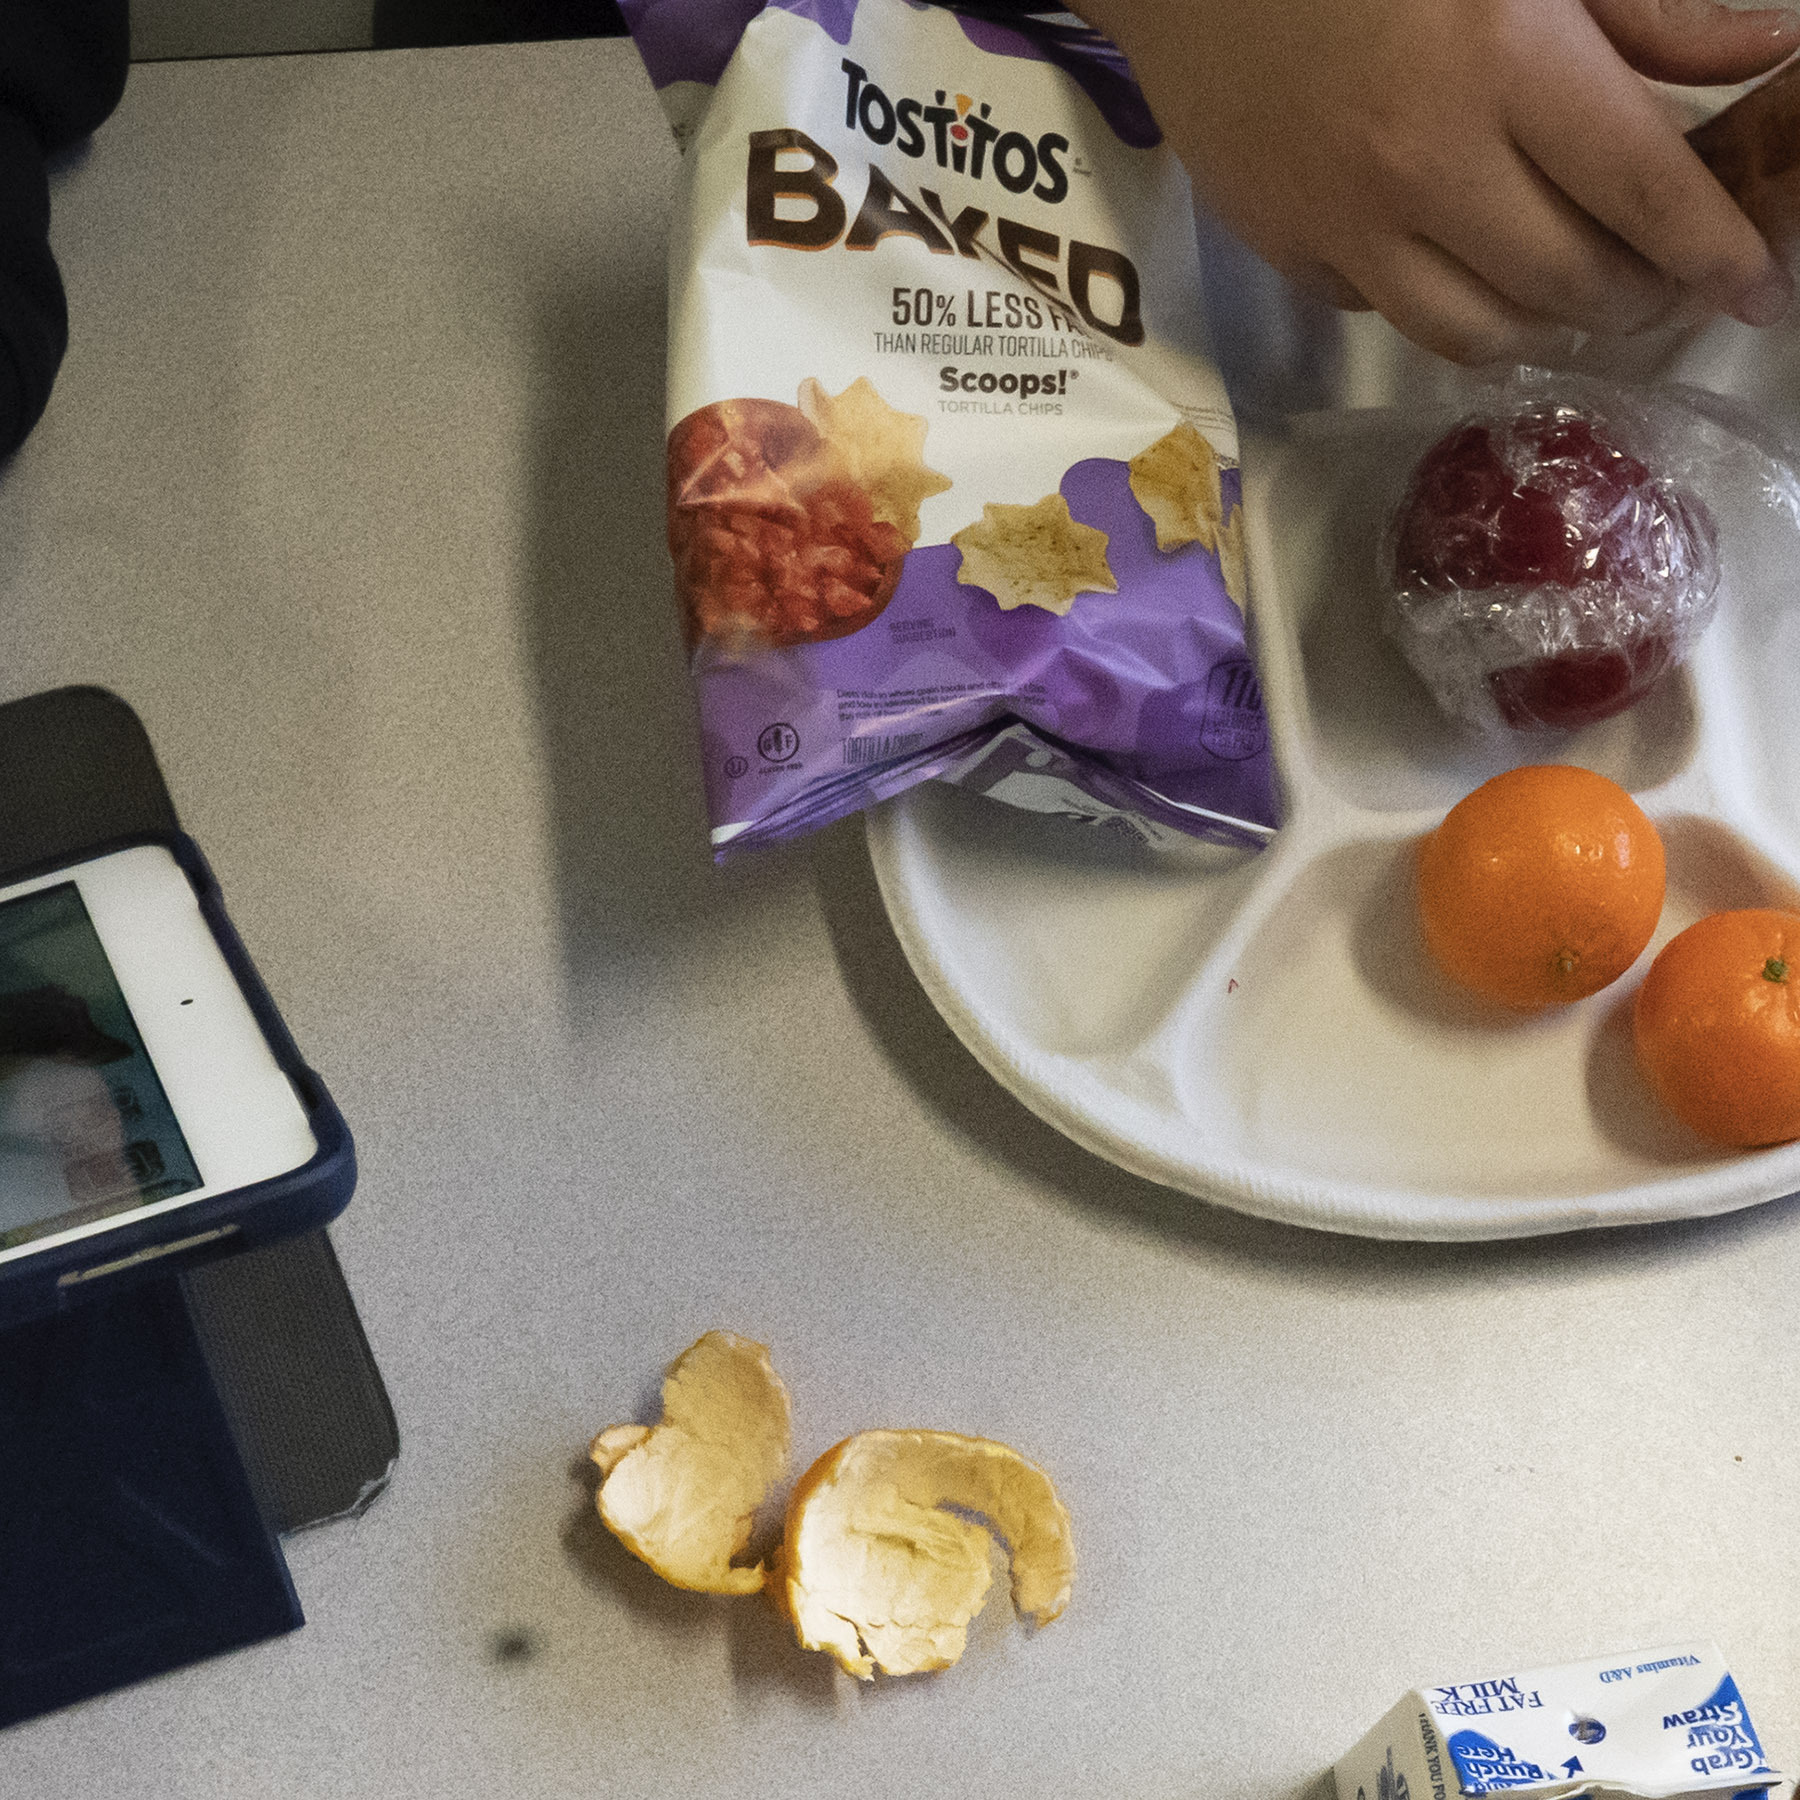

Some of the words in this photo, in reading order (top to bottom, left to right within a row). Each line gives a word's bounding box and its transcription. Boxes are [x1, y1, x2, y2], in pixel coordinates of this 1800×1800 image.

[745, 128, 1146, 347] BAKED
[893, 287, 956, 327] 50%
[967, 290, 1043, 329] LESS
[873, 333, 916, 354] THAN
[921, 334, 994, 356] REGULAR
[998, 336, 1069, 358] TORTILLA
[938, 401, 1013, 415] TORTILLA
[1018, 402, 1064, 416] CHIPS
[1600, 1667, 1633, 1683] A&D
[1635, 1654, 1701, 1676] Vitamins
[1433, 1676, 1521, 1701] MILK
[1431, 1699, 1494, 1716] FREE
[1498, 1690, 1545, 1712] FAT
[1662, 1701, 1743, 1731] Straw
[1687, 1728, 1753, 1750] Your
[1456, 1744, 1516, 1762] Here
[1690, 1749, 1755, 1775] Grab
[1427, 1755, 1443, 1782] YOU
